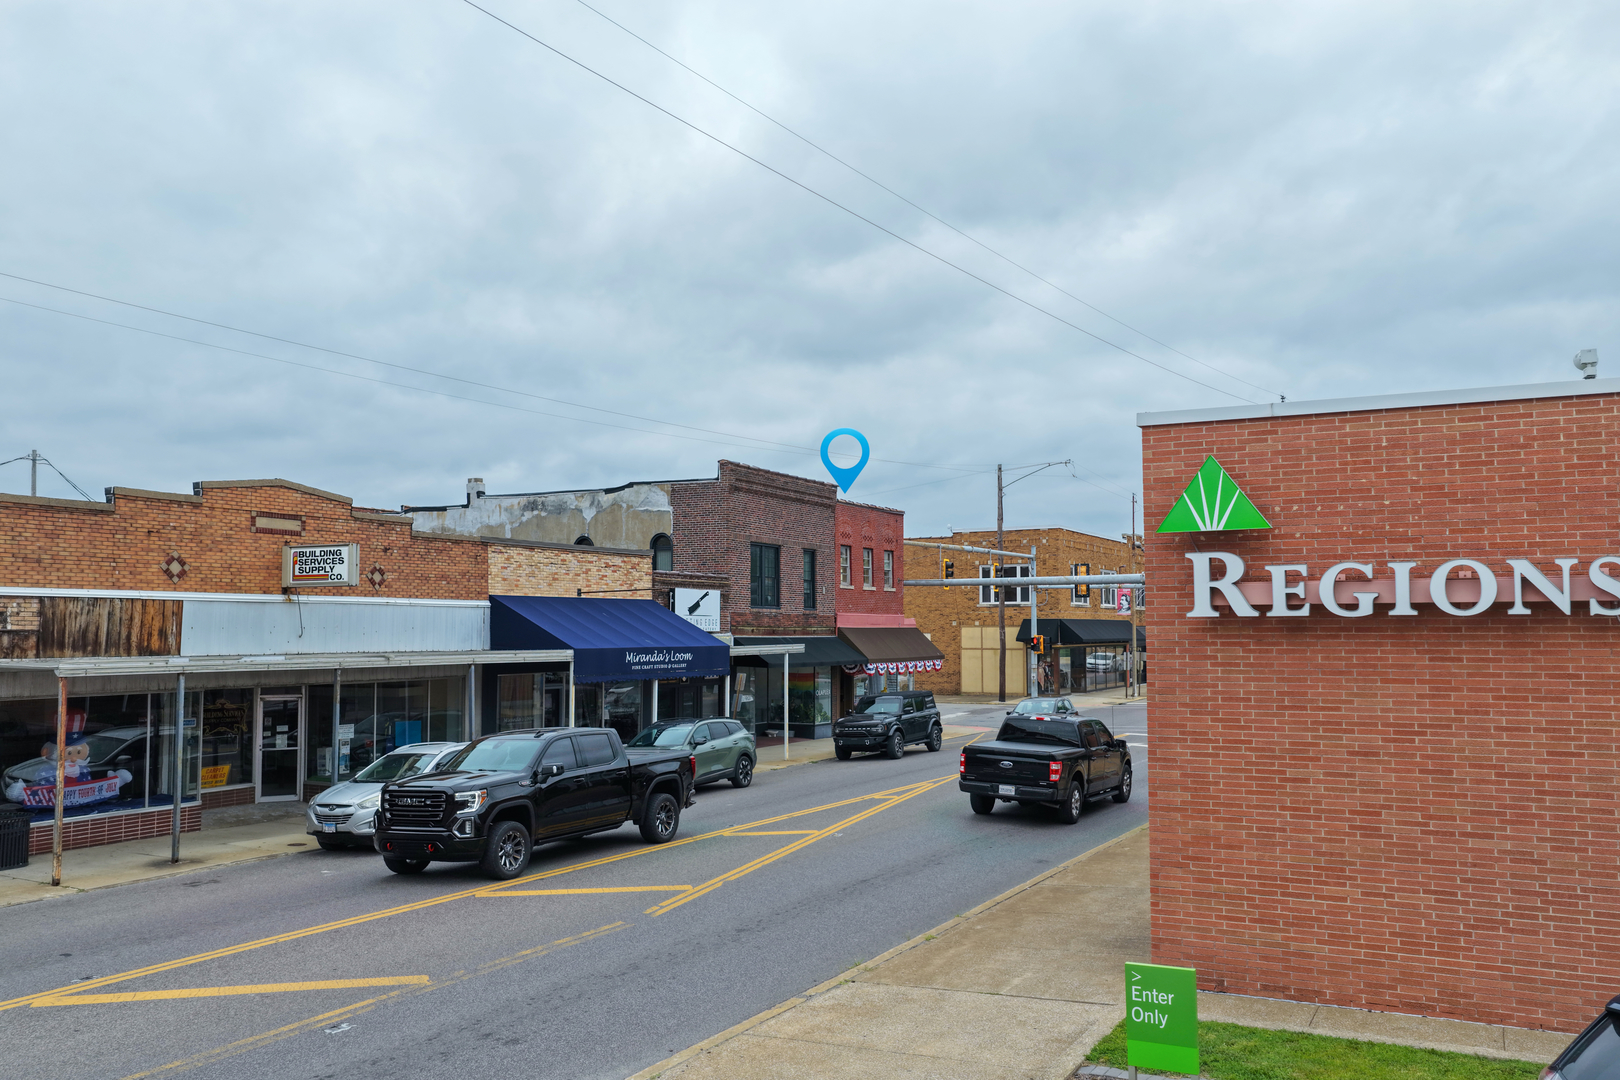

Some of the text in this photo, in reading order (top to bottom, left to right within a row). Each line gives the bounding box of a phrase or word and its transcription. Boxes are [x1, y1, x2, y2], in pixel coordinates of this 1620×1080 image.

[298, 549, 342, 558] BUILDING
[298, 557, 345, 566] SERVICES
[298, 566, 335, 574] SUPPLY
[329, 573, 345, 581] CO.
[1185, 551, 1620, 618] REGIONS
[704, 618, 718, 627] EDGE
[625, 649, 693, 663] Miranda's Loom
[205, 766, 225, 775] CARPET
[201, 772, 226, 781] CLEANERS
[105, 781, 118, 794] JULY
[1131, 985, 1175, 1005] Enter
[1131, 1006, 1168, 1029] Only
